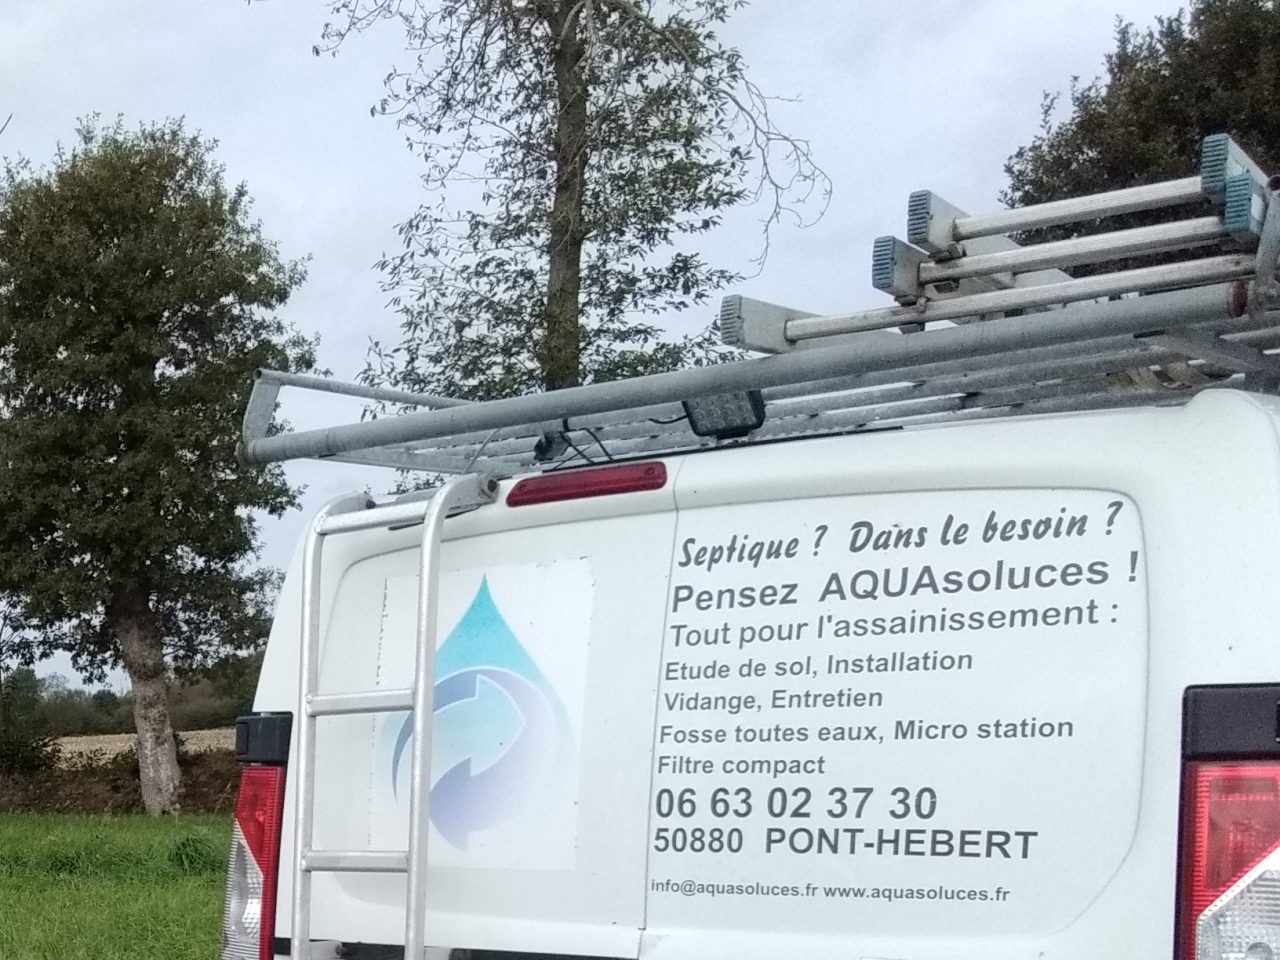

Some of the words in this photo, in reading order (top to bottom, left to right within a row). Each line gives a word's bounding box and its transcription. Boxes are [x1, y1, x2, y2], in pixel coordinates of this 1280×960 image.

[677, 535, 800, 573] Septique
[812, 524, 829, 557] ?
[848, 520, 928, 553] Dans
[940, 513, 970, 546] le
[981, 506, 1089, 544] besoin
[1105, 500, 1124, 536] ?
[672, 583, 799, 613] Pensez
[818, 559, 1109, 603] AQUAsoluces
[1128, 550, 1139, 583] !
[669, 622, 731, 648] Tout
[738, 622, 809, 650] pour
[817, 595, 1099, 639] l'assainissement
[1110, 603, 1119, 624] :
[665, 659, 731, 681] Etude
[738, 658, 767, 678] de
[774, 655, 818, 679] sol,
[827, 650, 973, 675] Installation
[664, 691, 762, 715] Vidange,
[771, 688, 883, 709] Entretien
[659, 725, 727, 744] Fosse
[734, 723, 809, 743] toutes
[817, 725, 884, 745] eaux,
[894, 719, 968, 740] Micro
[976, 716, 1074, 739] station
[657, 755, 714, 775] Filtre
[722, 755, 826, 779] compact
[655, 787, 697, 819] 06
[710, 787, 753, 818] 63
[767, 786, 812, 819] 02
[826, 786, 874, 819] 37
[888, 786, 937, 820] 30
[653, 827, 744, 854] 50880
[765, 827, 1039, 860] PONT-HEBERT
[651, 878, 819, 898] info@aquasoluces.fr
[823, 885, 1011, 903] www.aquasoluces.fr
